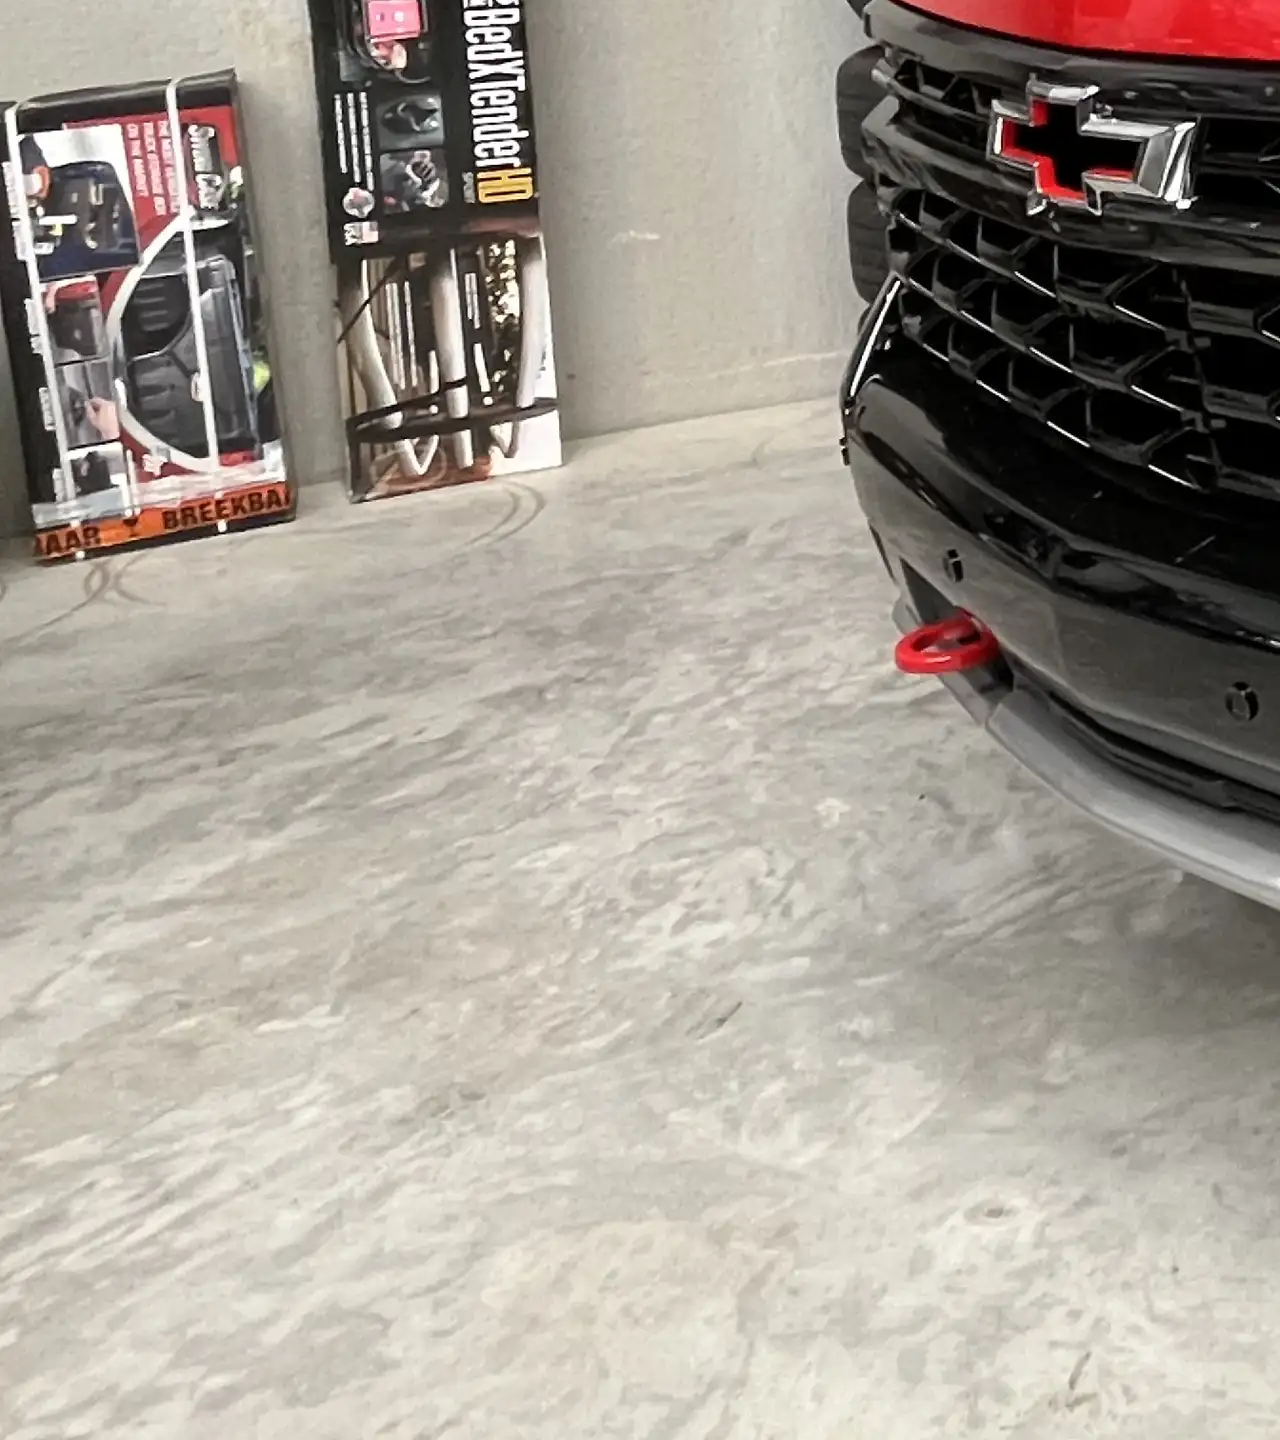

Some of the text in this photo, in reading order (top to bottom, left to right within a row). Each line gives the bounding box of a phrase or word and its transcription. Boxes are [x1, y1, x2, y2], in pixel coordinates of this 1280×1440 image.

[463, 7, 534, 204] BedXTender HD
[34, 526, 102, 556] AAR
